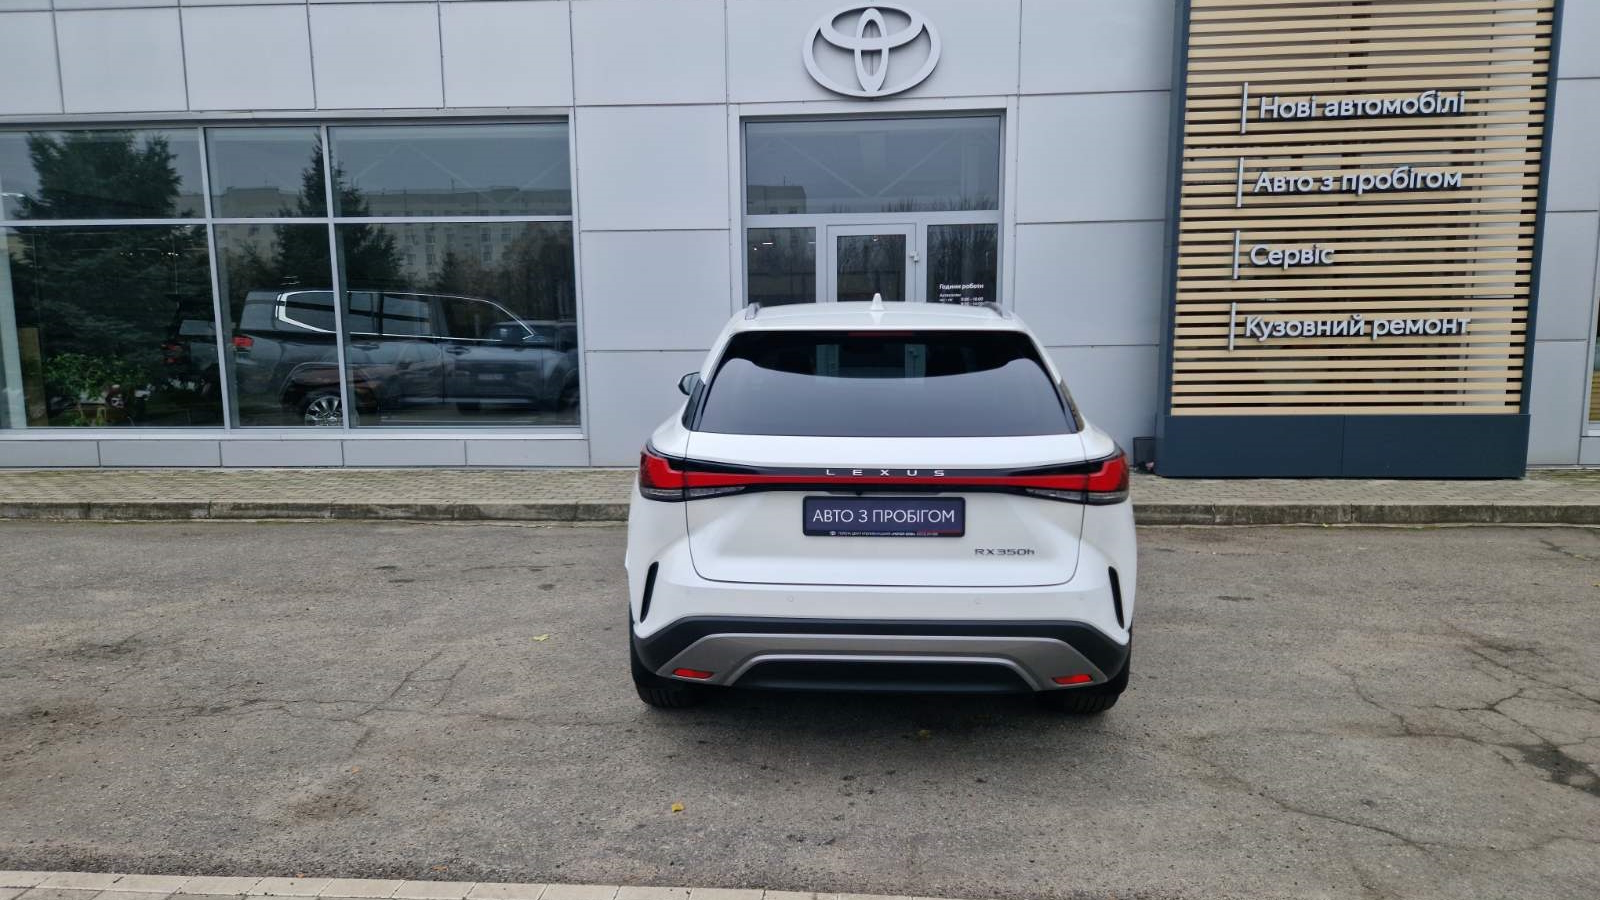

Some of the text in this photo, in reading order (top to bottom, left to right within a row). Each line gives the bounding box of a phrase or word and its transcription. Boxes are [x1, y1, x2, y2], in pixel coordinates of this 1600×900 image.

[1259, 90, 1465, 120] Нові автомобілі
[1254, 166, 1463, 195] Авто з пробігом
[1250, 243, 1335, 270] Сервіс
[1245, 314, 1471, 341] Кузовний ремонт
[826, 469, 945, 477] LEXUS
[812, 509, 955, 523] АВТО З ПРОБІГОМ
